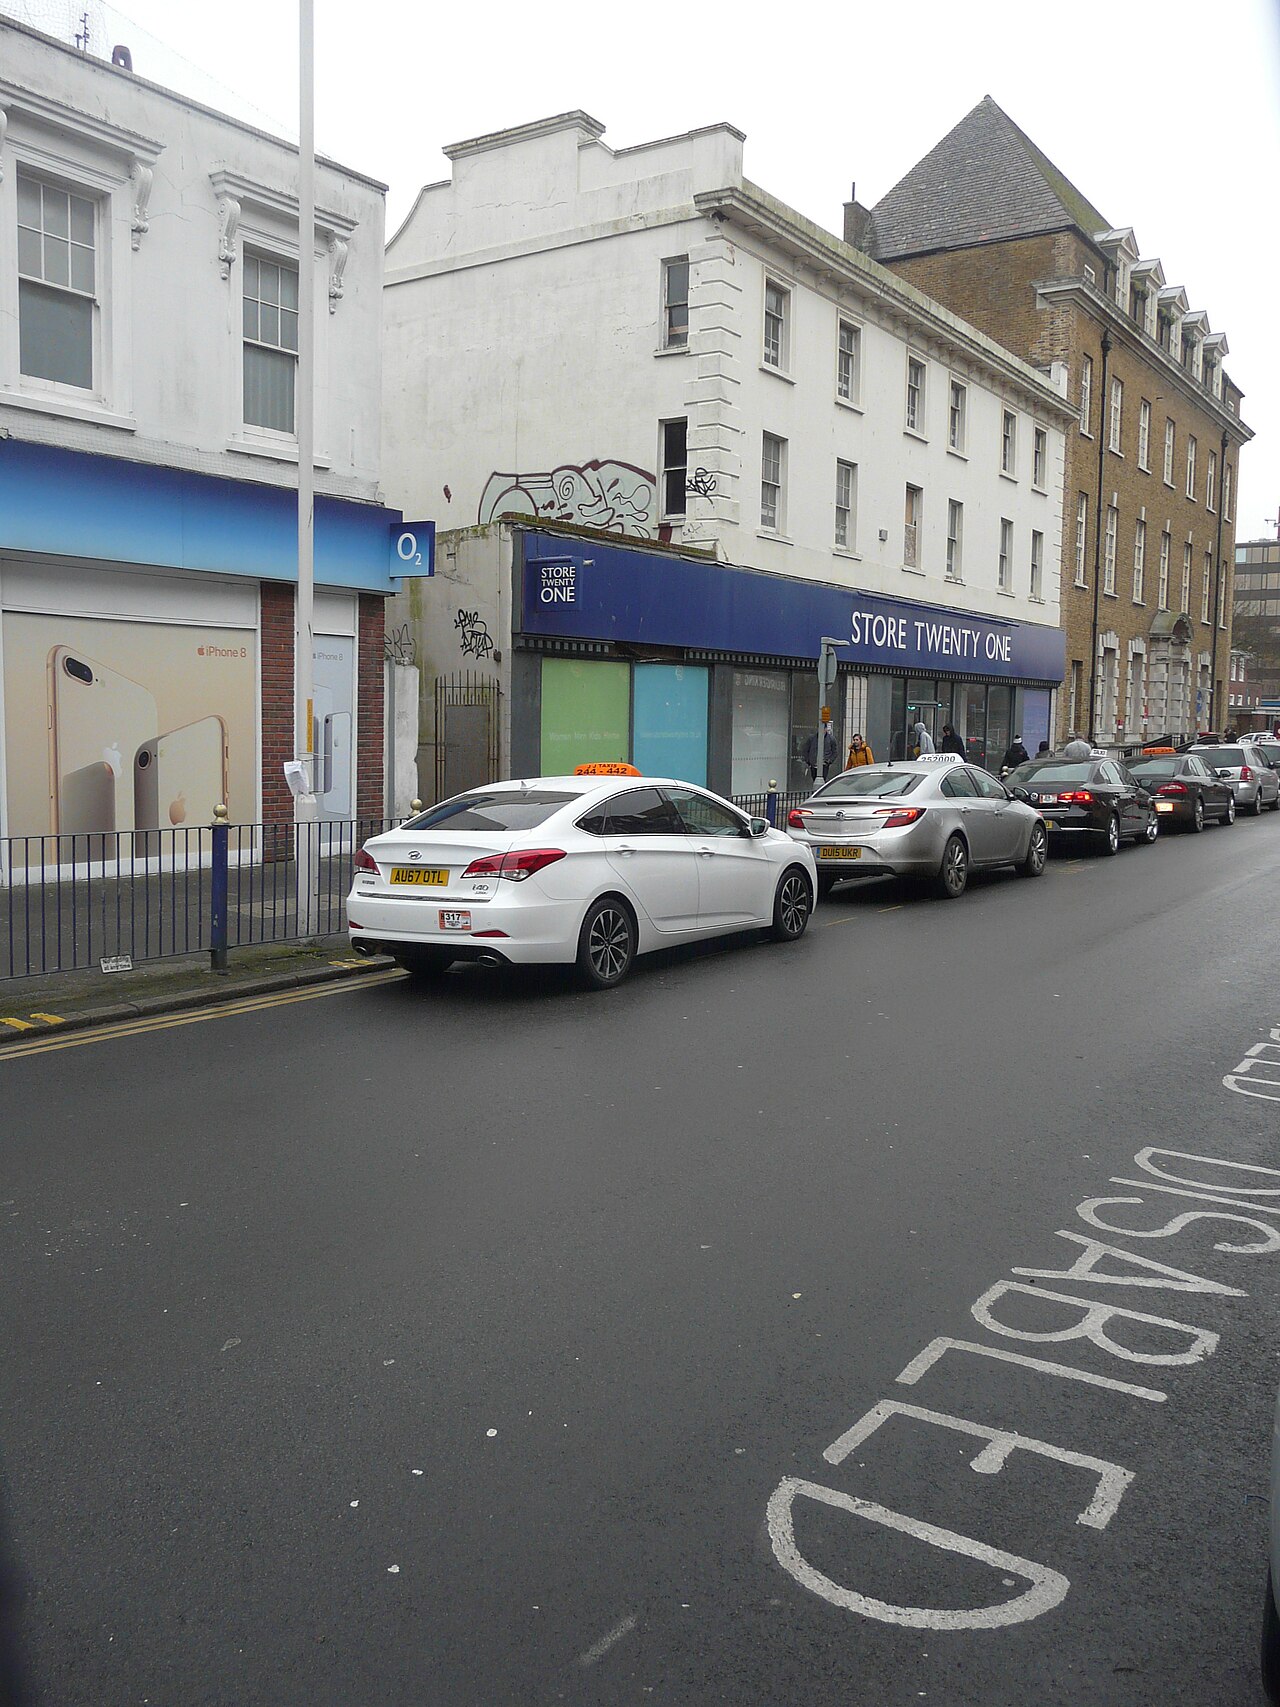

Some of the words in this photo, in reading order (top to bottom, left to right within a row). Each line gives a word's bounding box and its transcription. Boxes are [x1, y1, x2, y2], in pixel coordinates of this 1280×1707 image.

[397, 532, 422, 566] O2
[541, 566, 576, 579] STORE
[541, 578, 576, 587] TWENTY
[540, 586, 576, 603] ONE
[851, 611, 907, 650] STORE
[914, 621, 981, 659] TWENTY
[985, 632, 1012, 662] ONE
[206, 645, 238, 658] iPhone
[240, 647, 247, 658] 8
[317, 652, 338, 661] iPhone
[338, 653, 344, 661] 8
[576, 768, 597, 776] 244
[606, 767, 628, 775] 442
[841, 848, 858, 857] UKR
[394, 868, 420, 882] AU67
[423, 870, 444, 884] OTL
[766, 1146, 1280, 1631] DISABLED
